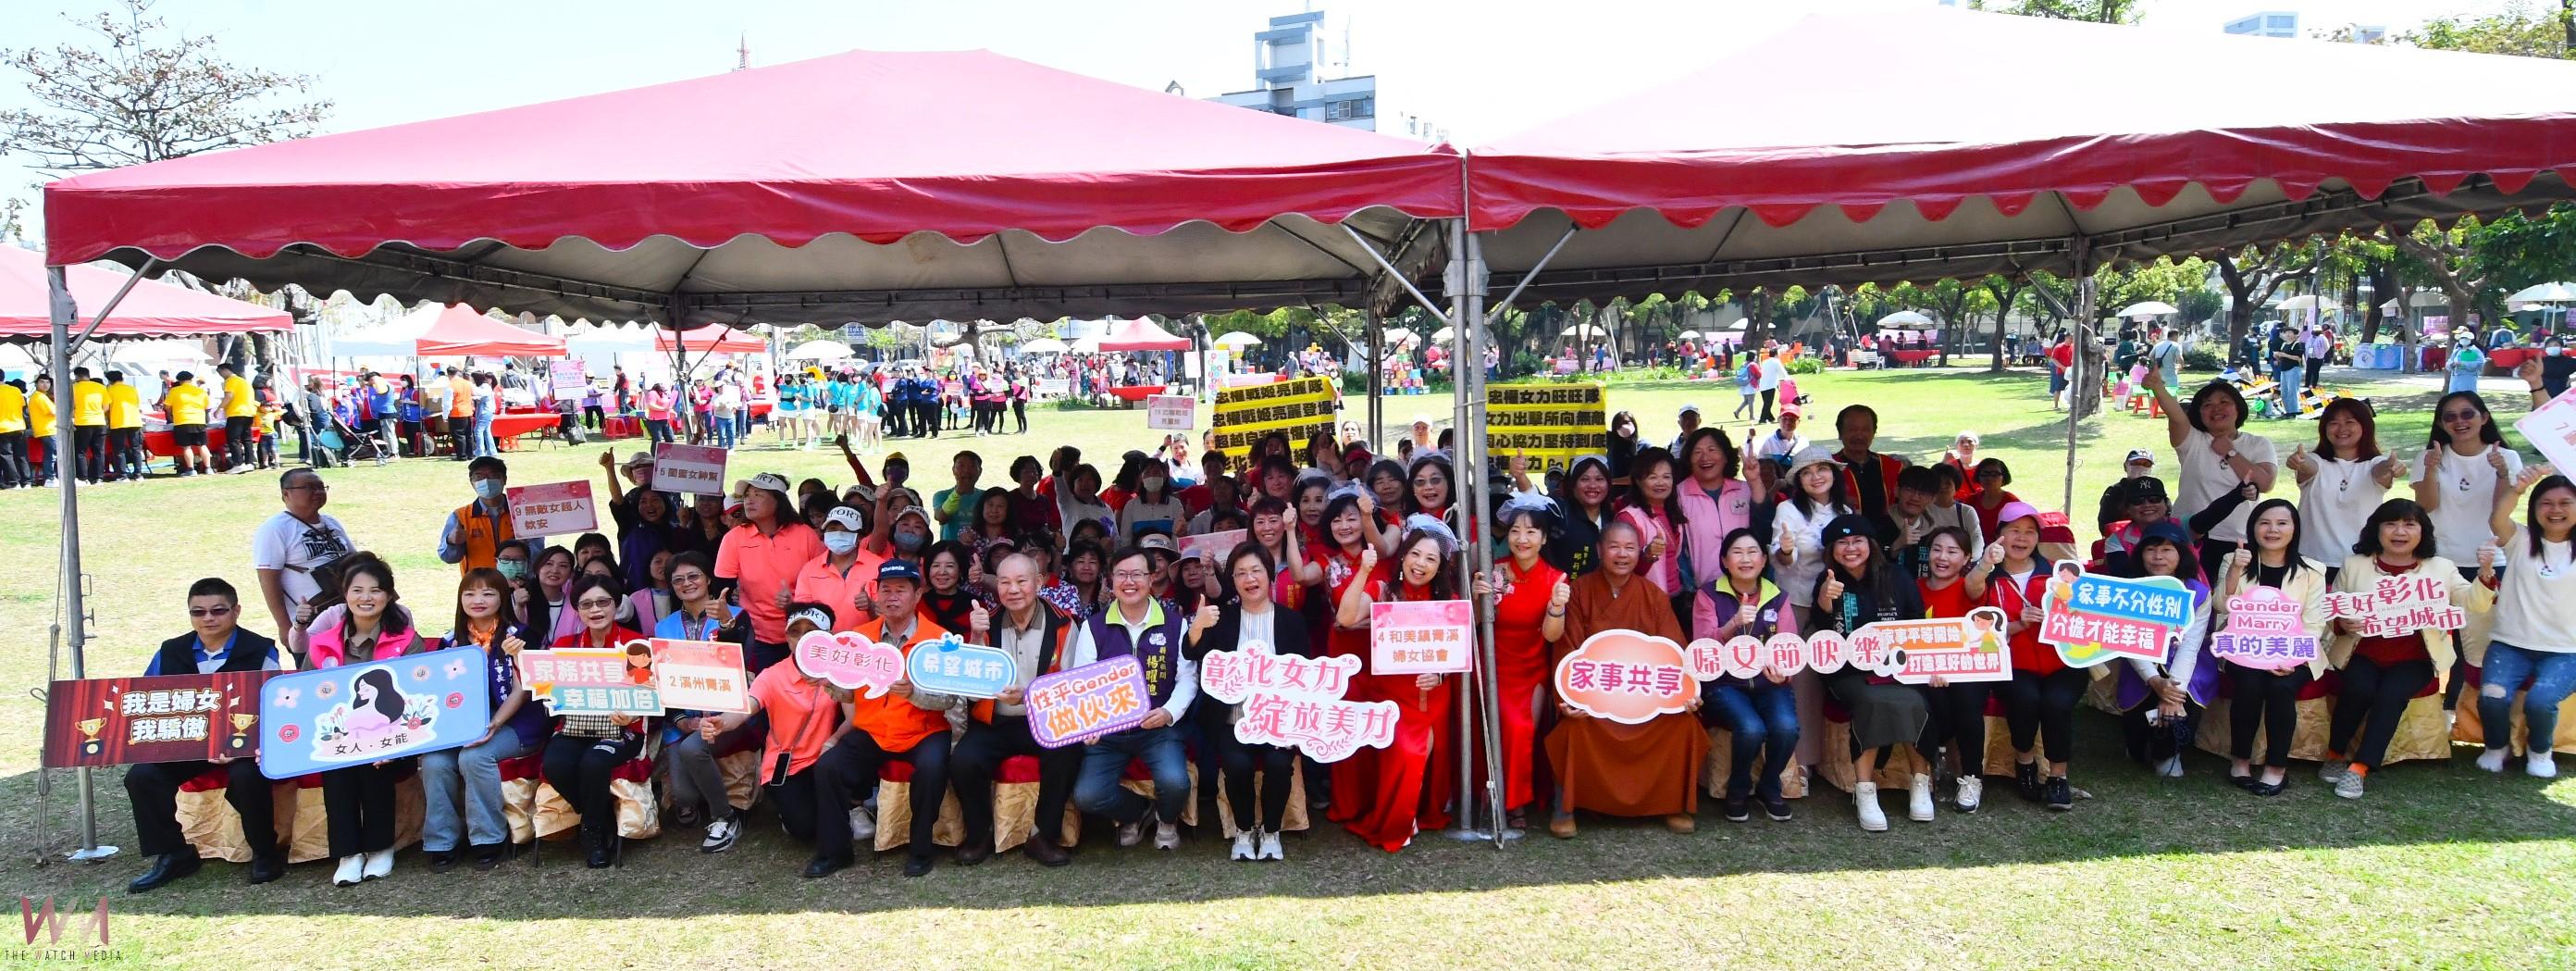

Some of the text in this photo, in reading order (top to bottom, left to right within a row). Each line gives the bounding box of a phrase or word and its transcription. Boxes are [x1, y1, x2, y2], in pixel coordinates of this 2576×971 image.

[1488, 389, 1600, 404] 忠權女力旺旺隊
[515, 507, 522, 517] 9
[2078, 581, 2182, 619] 家事不分性別
[2229, 599, 2299, 613] Gender
[2051, 613, 2155, 650] 分擔才能幸福
[2237, 616, 2291, 631] Marry
[2361, 606, 2463, 637] 希望城市
[1378, 631, 1385, 643] 4
[2215, 634, 2315, 658] 真的美麗
[810, 644, 895, 674] 美好彰化
[922, 652, 1004, 683] 希望城市
[1393, 649, 1449, 664] 婦女協會
[1693, 636, 1881, 676] 婦女節快樂
[1909, 652, 2000, 673] 打造更好的世界
[532, 659, 626, 684] 家務共享
[670, 676, 676, 687] 2
[1204, 653, 1342, 692] 彰化女力
[1571, 660, 1682, 696] 家事共享
[122, 688, 221, 716] 我是婦女
[563, 688, 655, 711] 幸福加倍
[1047, 683, 1140, 739] 做伙來
[132, 716, 208, 742] 我驕傲
[1249, 692, 1390, 740] 綻放美力
